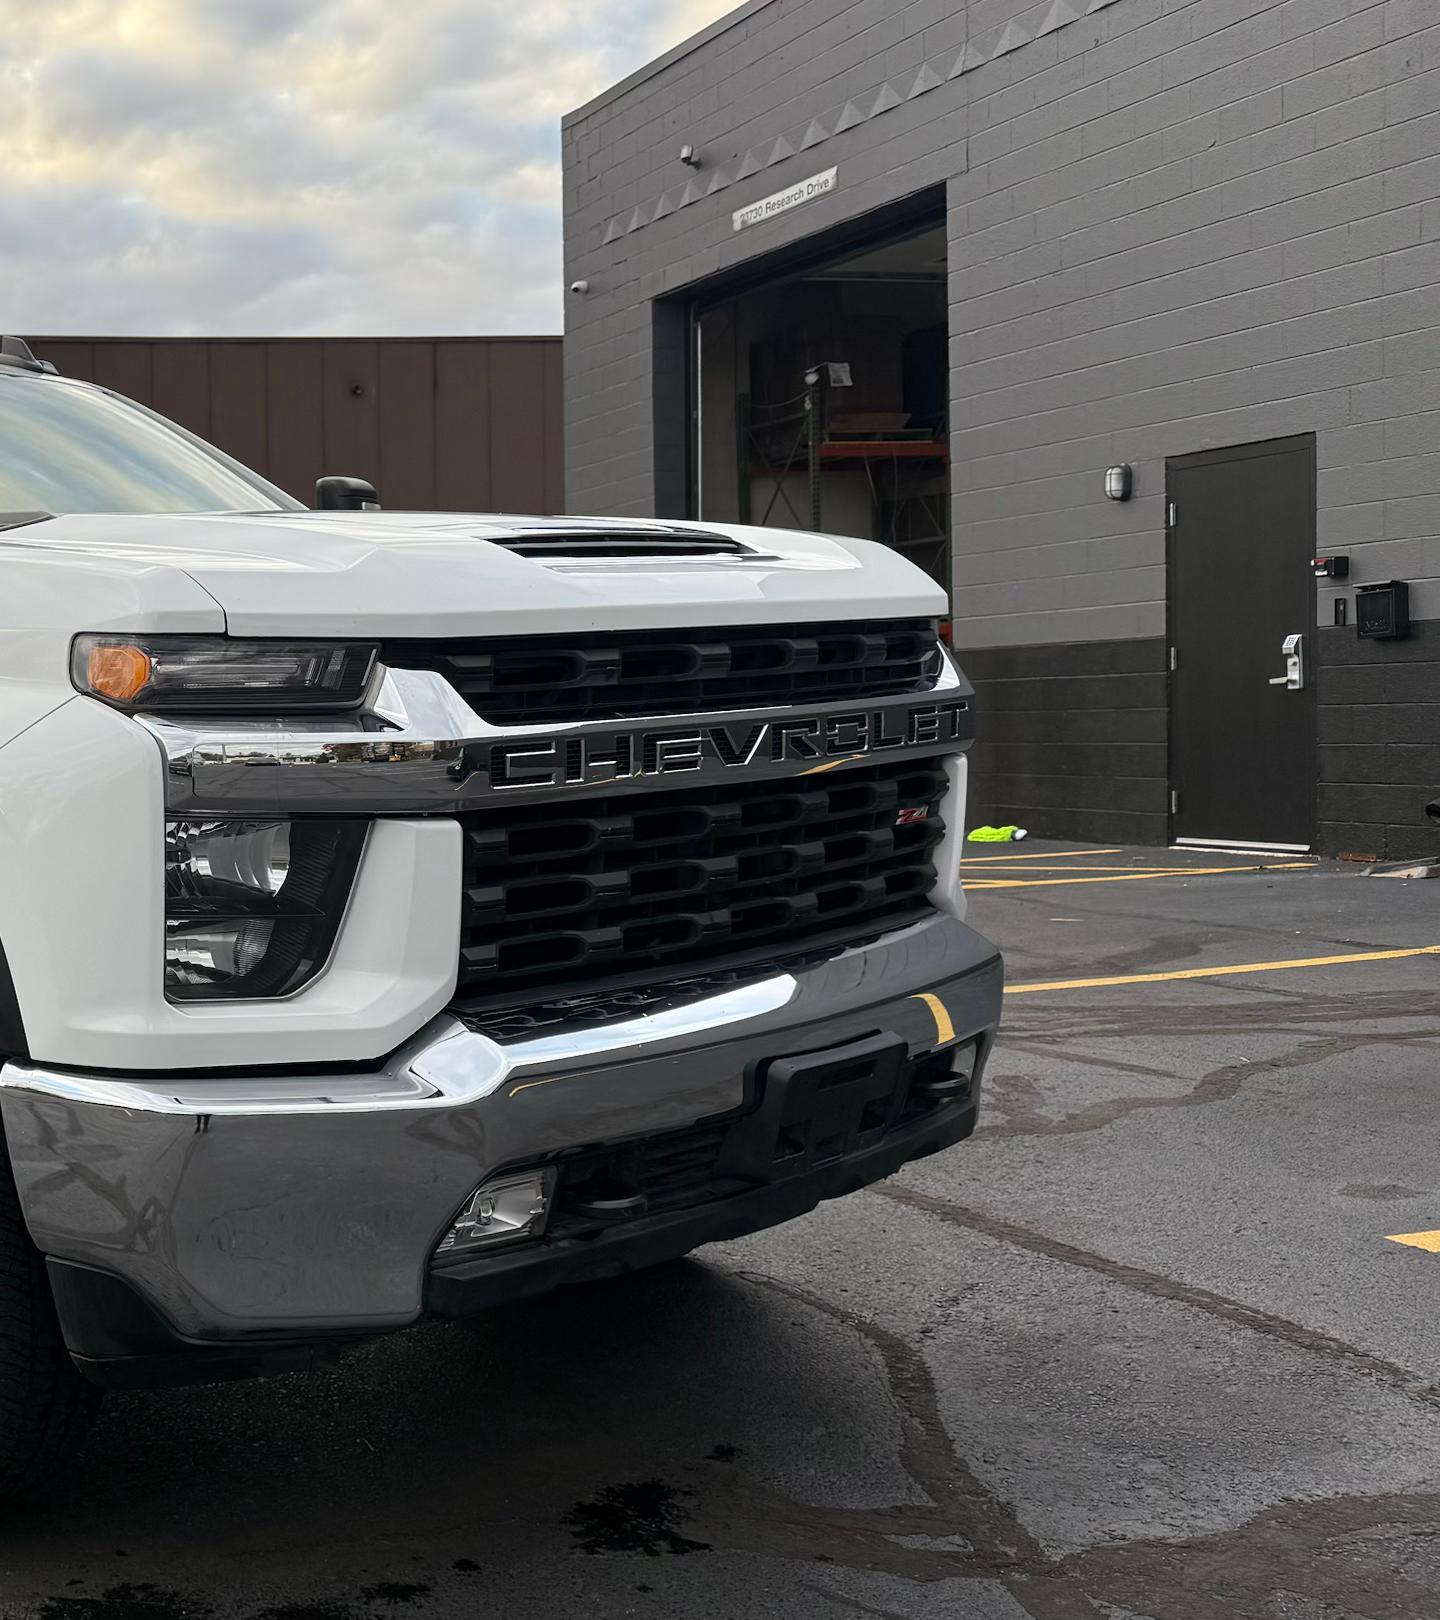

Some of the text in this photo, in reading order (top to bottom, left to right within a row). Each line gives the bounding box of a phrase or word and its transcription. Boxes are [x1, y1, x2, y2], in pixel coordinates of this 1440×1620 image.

[765, 189, 804, 214] Research
[807, 178, 829, 195] Drive
[490, 702, 968, 789] CHEVROLET
